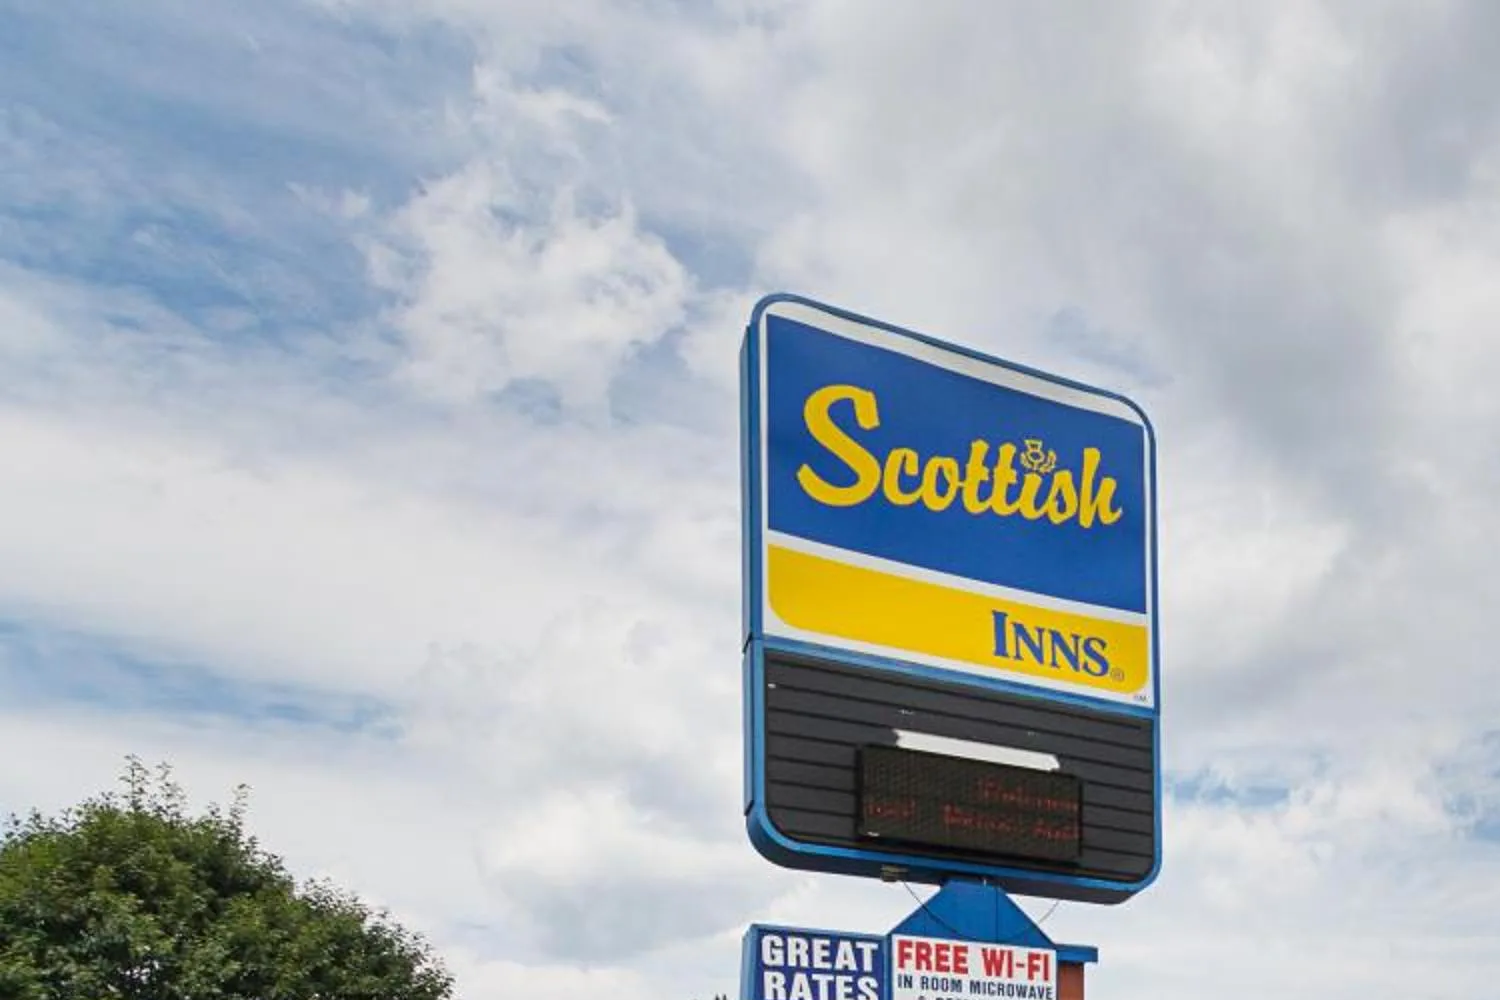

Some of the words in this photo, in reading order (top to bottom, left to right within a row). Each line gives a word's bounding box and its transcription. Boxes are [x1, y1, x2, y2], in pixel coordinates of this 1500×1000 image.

[796, 384, 1122, 528] Scottish
[761, 935, 878, 972] GREAT
[897, 939, 969, 975] FREE
[981, 948, 1050, 981] WI-FI
[898, 975, 913, 989] IN
[920, 976, 963, 993] ROOM
[970, 980, 1053, 1000] MICROWAVE
